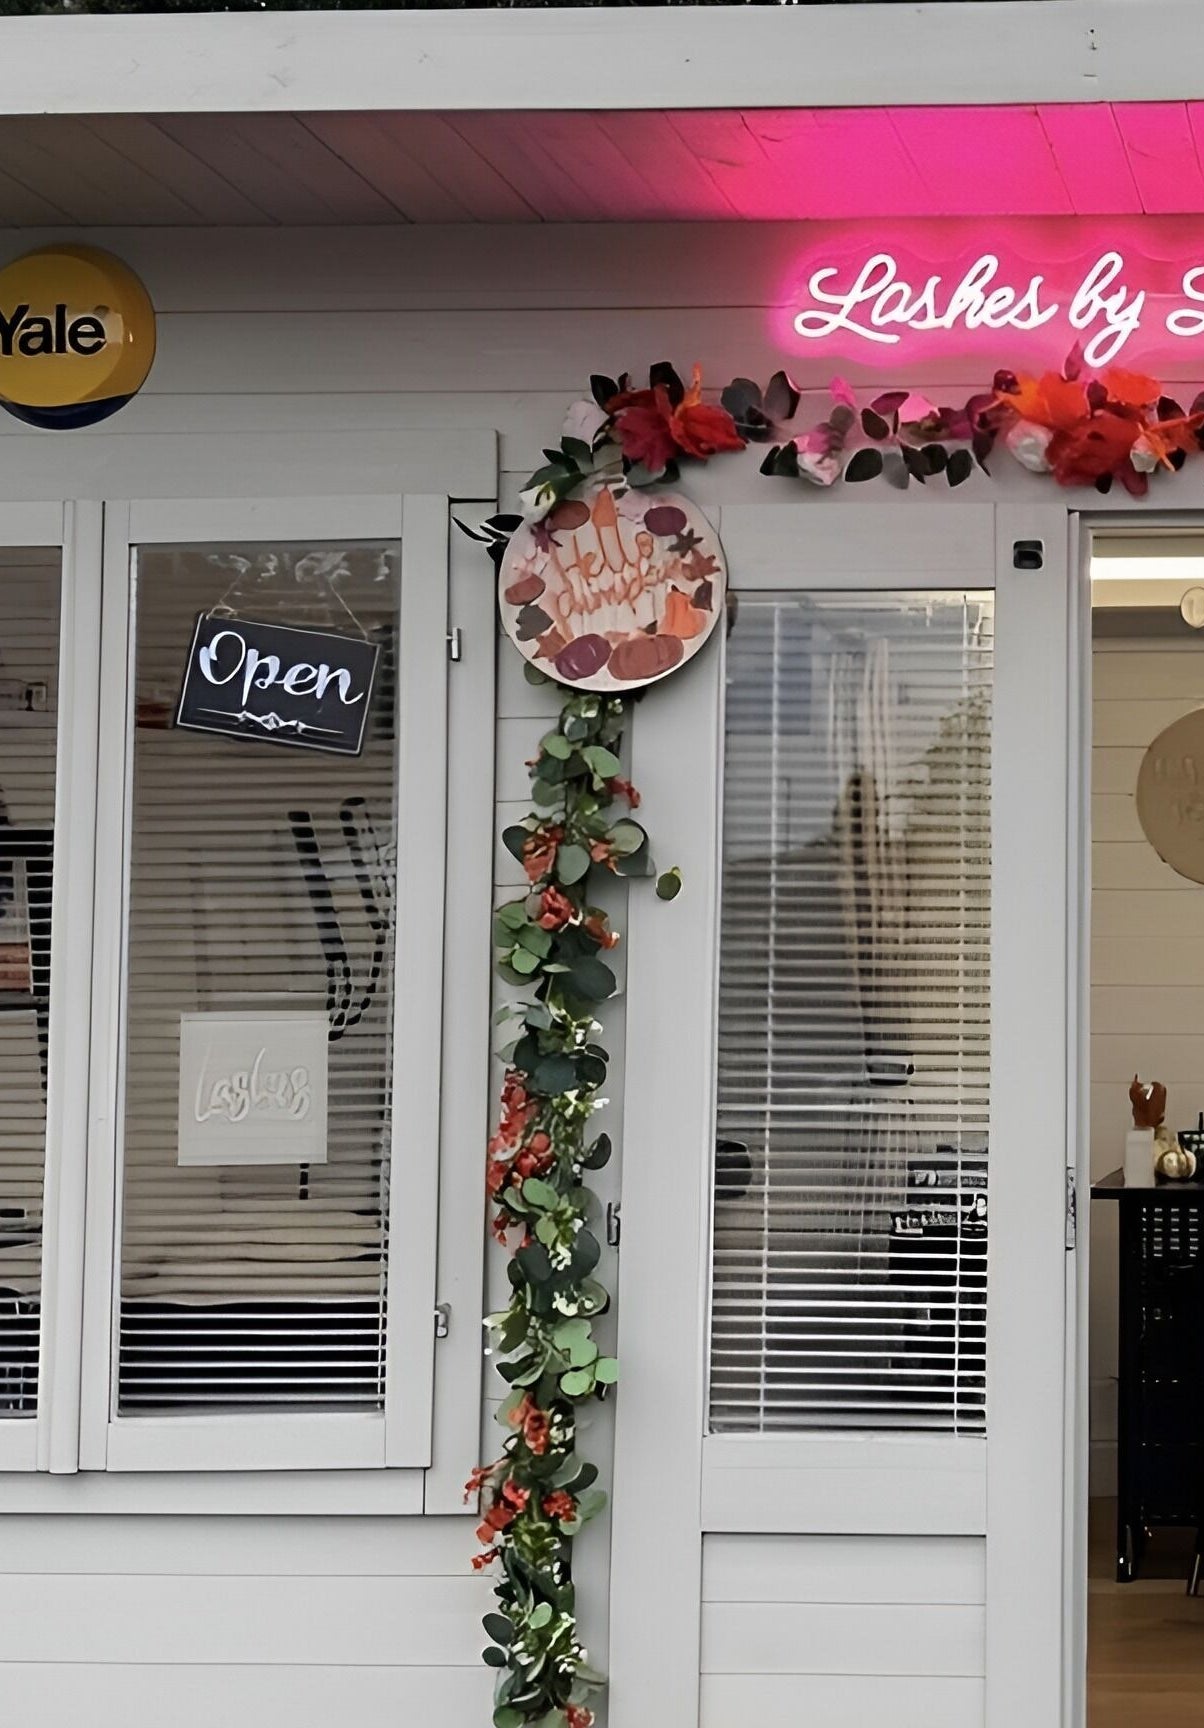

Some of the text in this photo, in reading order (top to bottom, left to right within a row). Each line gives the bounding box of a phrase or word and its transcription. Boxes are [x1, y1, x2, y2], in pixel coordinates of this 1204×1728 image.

[0, 303, 107, 356] Yale
[795, 253, 1059, 344] Lashes
[1069, 251, 1146, 368] by
[199, 630, 364, 706] Open
